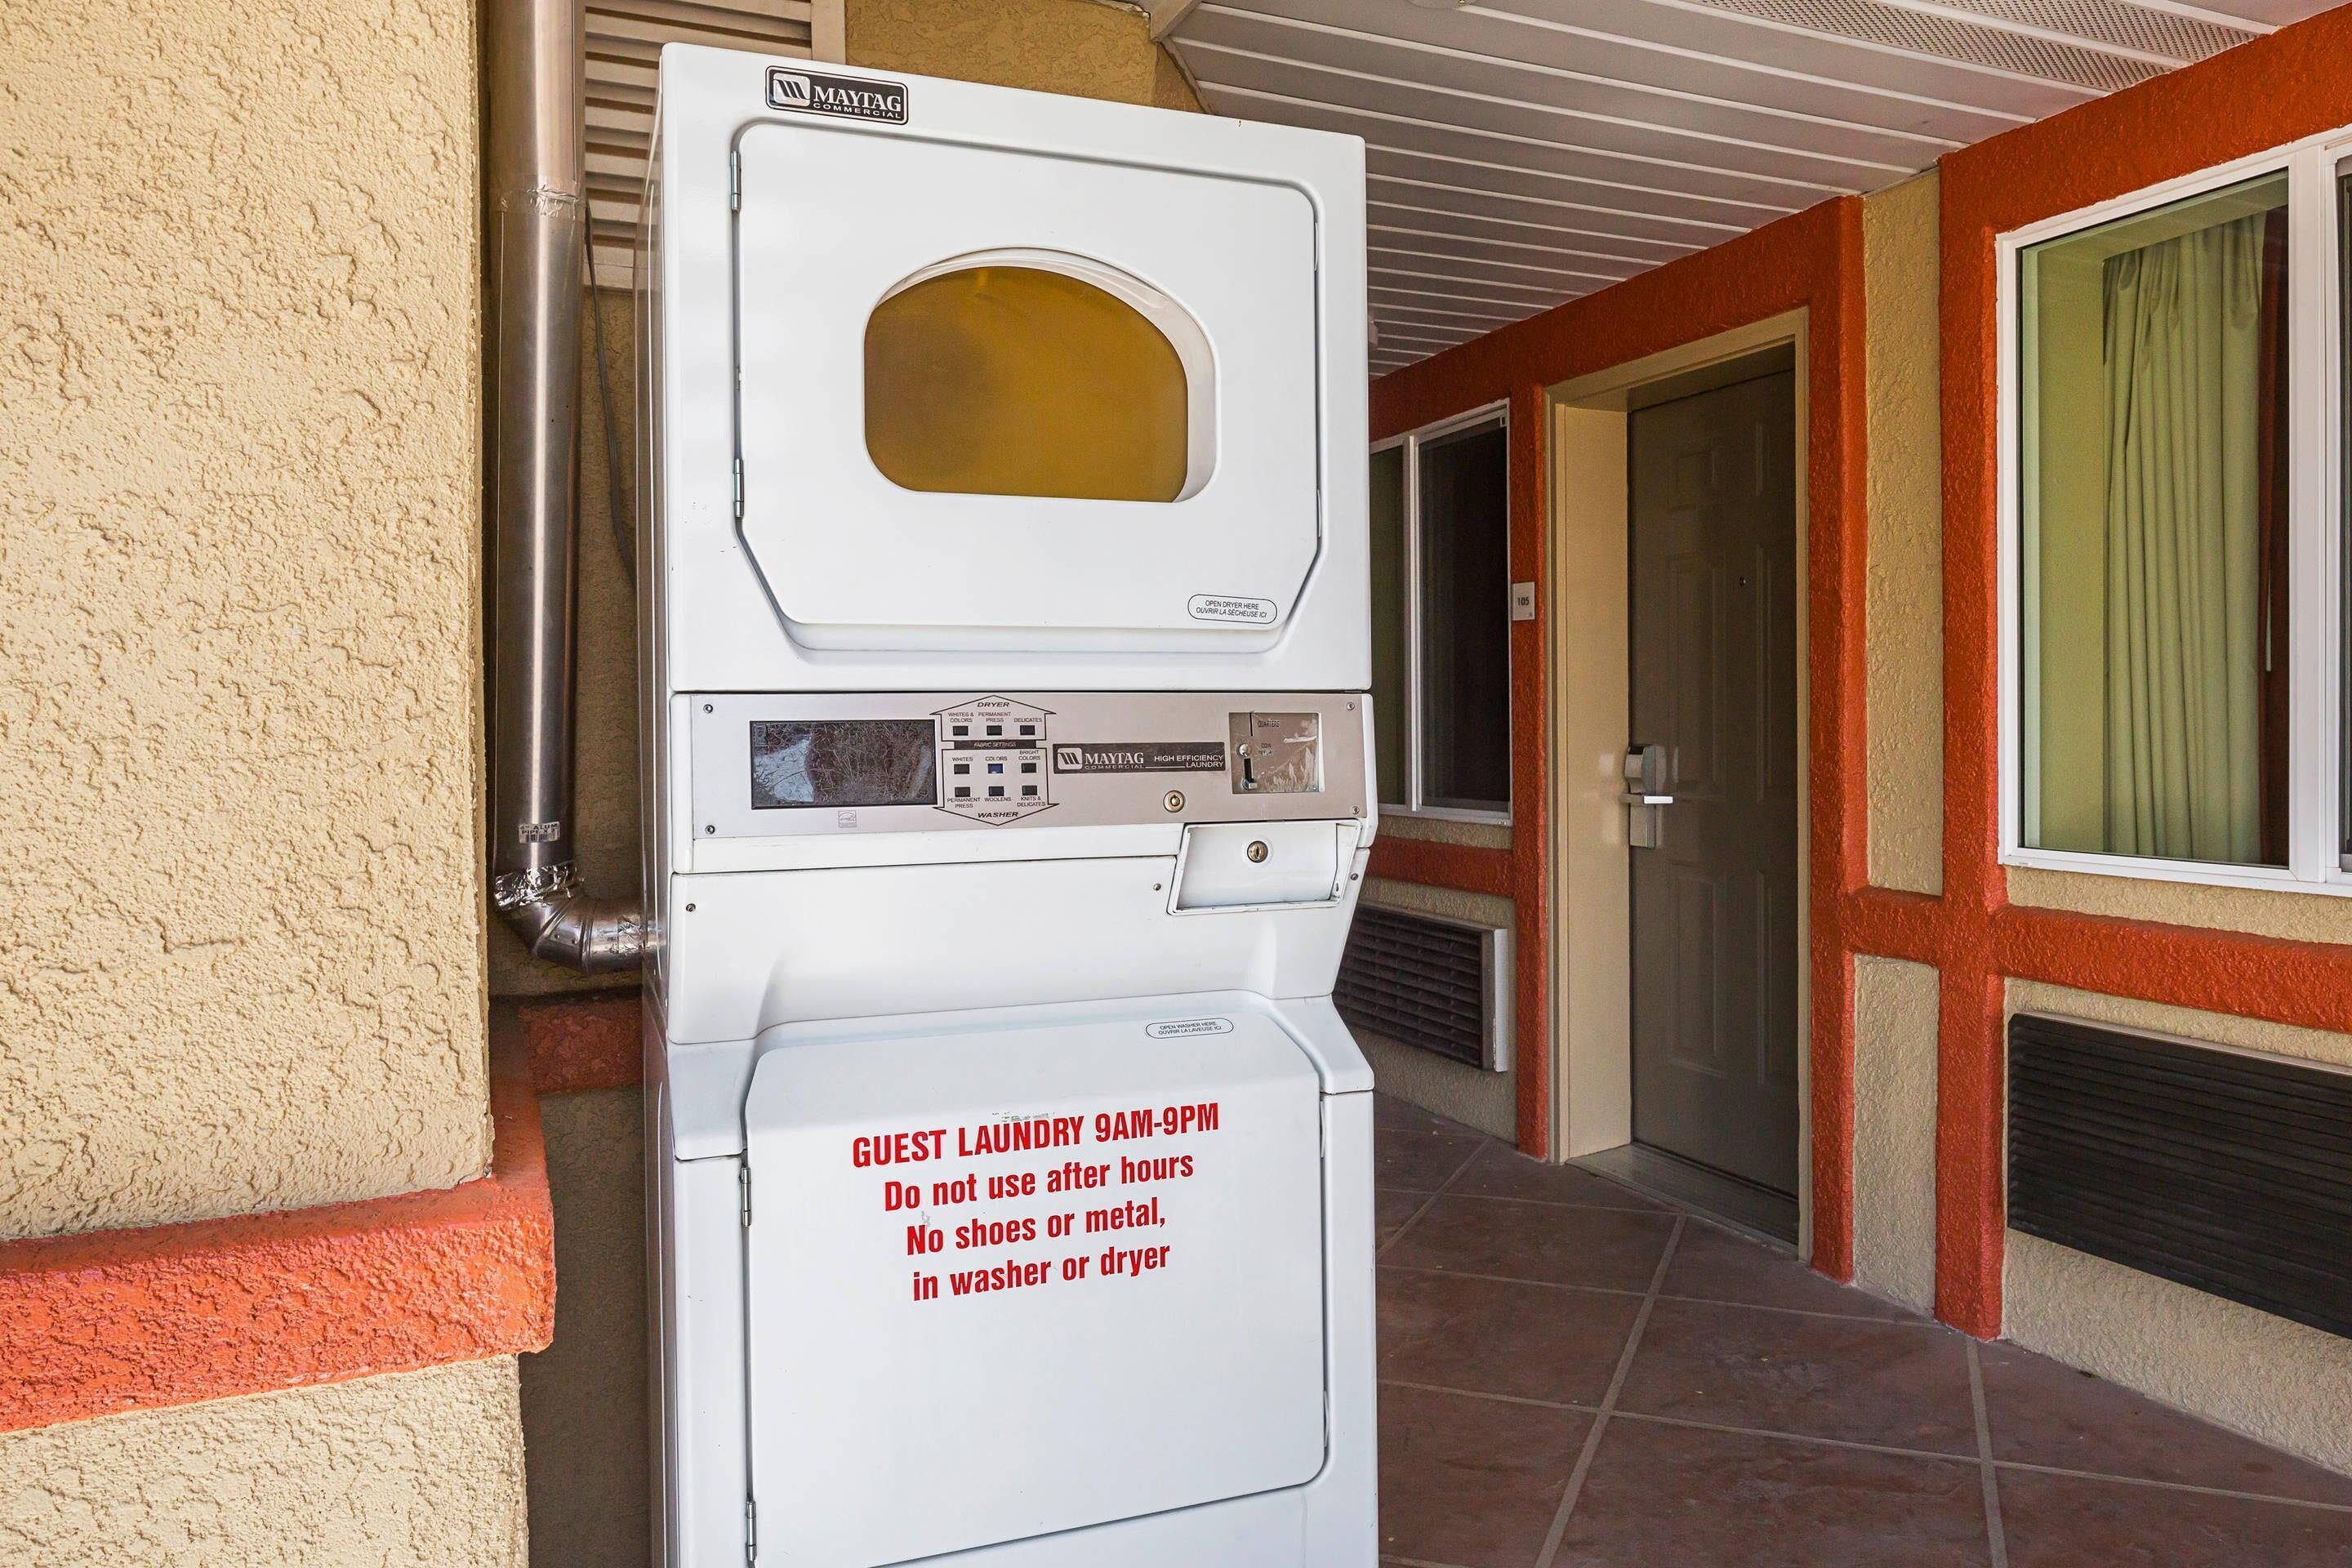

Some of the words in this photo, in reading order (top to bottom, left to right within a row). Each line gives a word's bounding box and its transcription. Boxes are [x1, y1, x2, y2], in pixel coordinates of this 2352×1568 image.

[813, 85, 902, 112] MAYTAG
[813, 103, 902, 118] COMMERCIAL
[1517, 596, 1530, 606] 105
[1085, 752, 1143, 765] MAYTAG
[853, 1129, 946, 1168] GUEST
[959, 1116, 1084, 1157] LAUNDRY
[1095, 1102, 1219, 1143] 9AM-9PM
[885, 1181, 920, 1212] Do
[933, 1174, 977, 1206] not
[989, 1173, 1036, 1200] use
[1047, 1163, 1111, 1193] after
[1121, 1155, 1193, 1184] hours
[907, 1225, 943, 1255] No
[956, 1218, 1036, 1250] shoes
[1048, 1214, 1074, 1238] or
[1086, 1197, 1165, 1233] metal,
[913, 1272, 938, 1301] in
[951, 1260, 1051, 1296] washer
[1063, 1257, 1089, 1281] or
[1101, 1245, 1170, 1277] dryer
